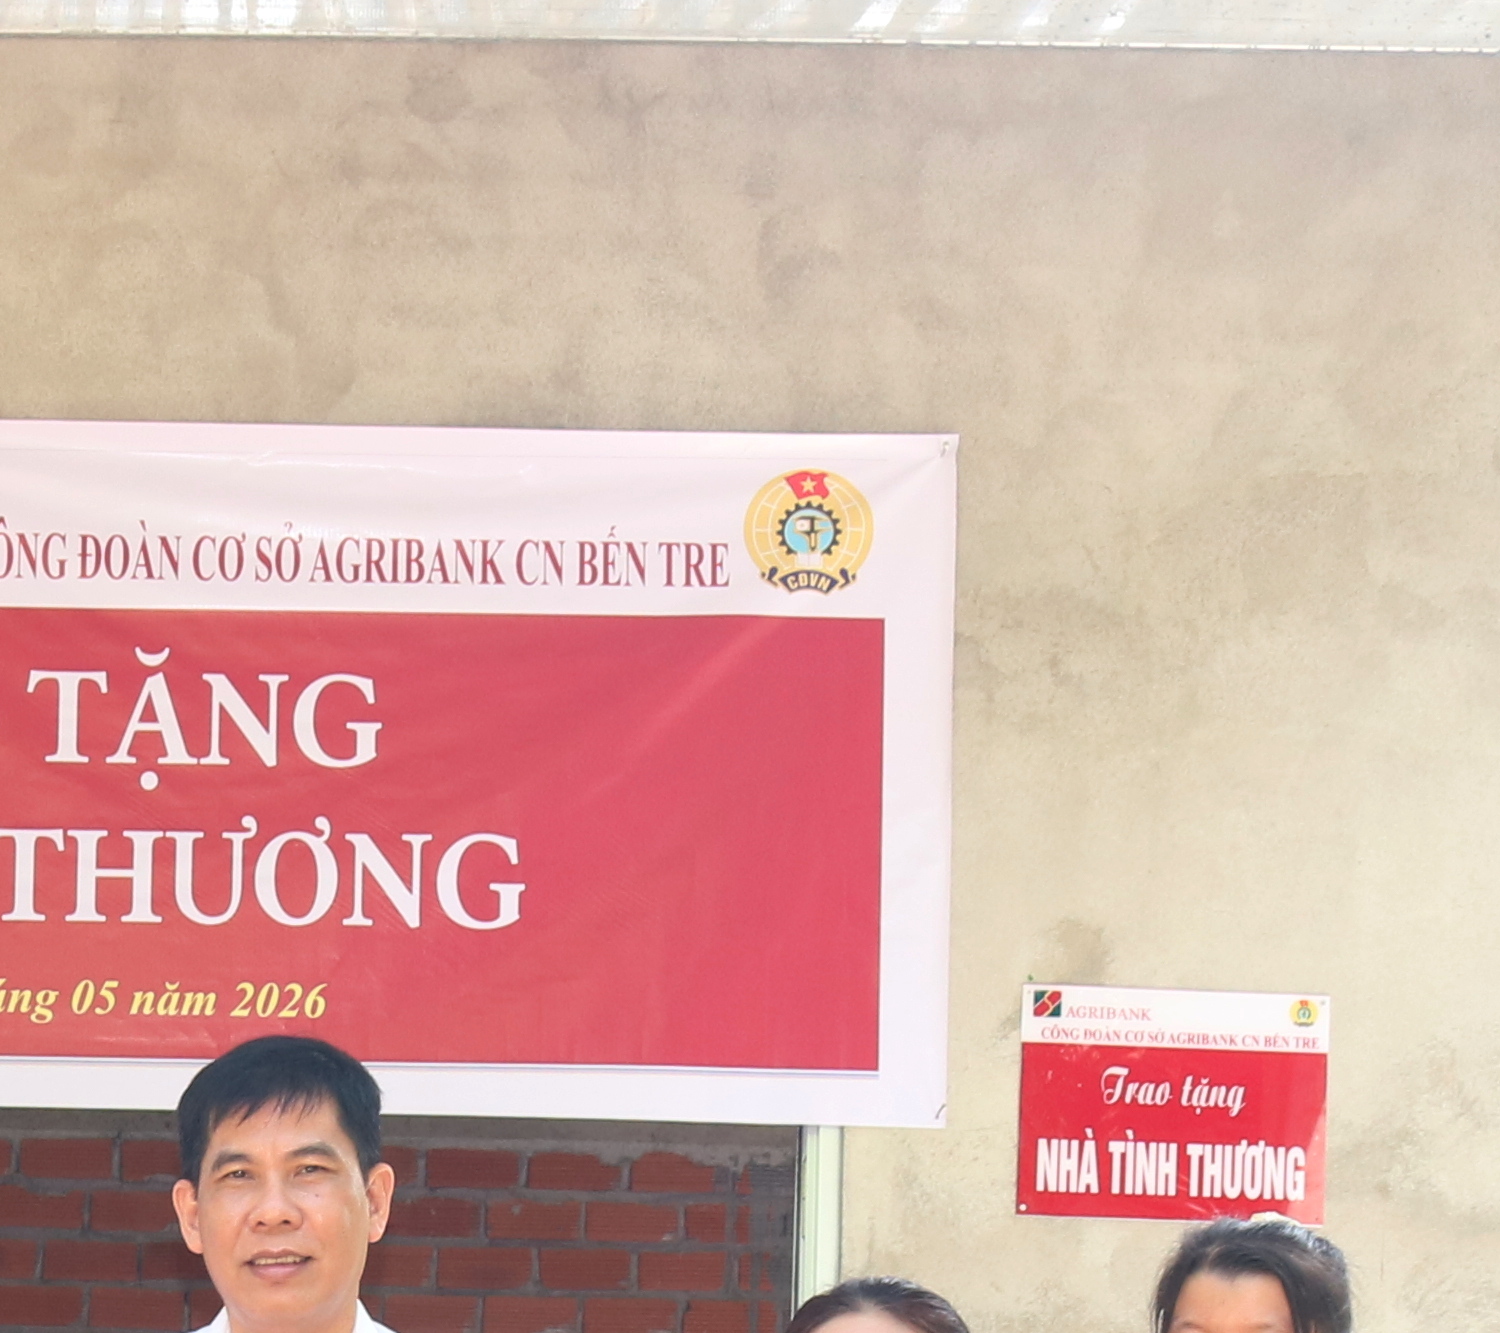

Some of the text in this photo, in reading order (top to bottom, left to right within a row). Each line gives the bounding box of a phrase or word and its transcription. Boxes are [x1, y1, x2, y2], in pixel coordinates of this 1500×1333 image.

[78, 520, 182, 581] ĐOÀN
[192, 532, 245, 582] CƠ
[255, 521, 303, 583] SỞ
[310, 536, 506, 586] AGRIBANK
[516, 538, 565, 586] CN
[577, 526, 648, 587] BẾN
[658, 541, 730, 588] TRE
[26, 646, 383, 791] TẶNG
[71, 979, 119, 1017] 05
[130, 982, 217, 1018] năm
[230, 981, 327, 1019] 2026
[1065, 1005, 1152, 1021] AGRIBANK
[1167, 1031, 1239, 1047] AGRIBANK
[1242, 1034, 1262, 1047] CN
[1292, 1036, 1320, 1049] TRE
[1101, 1065, 1247, 1118] Trao tặng
[1035, 1127, 1306, 1201] NHÀ TÌNH THƯƠNG
